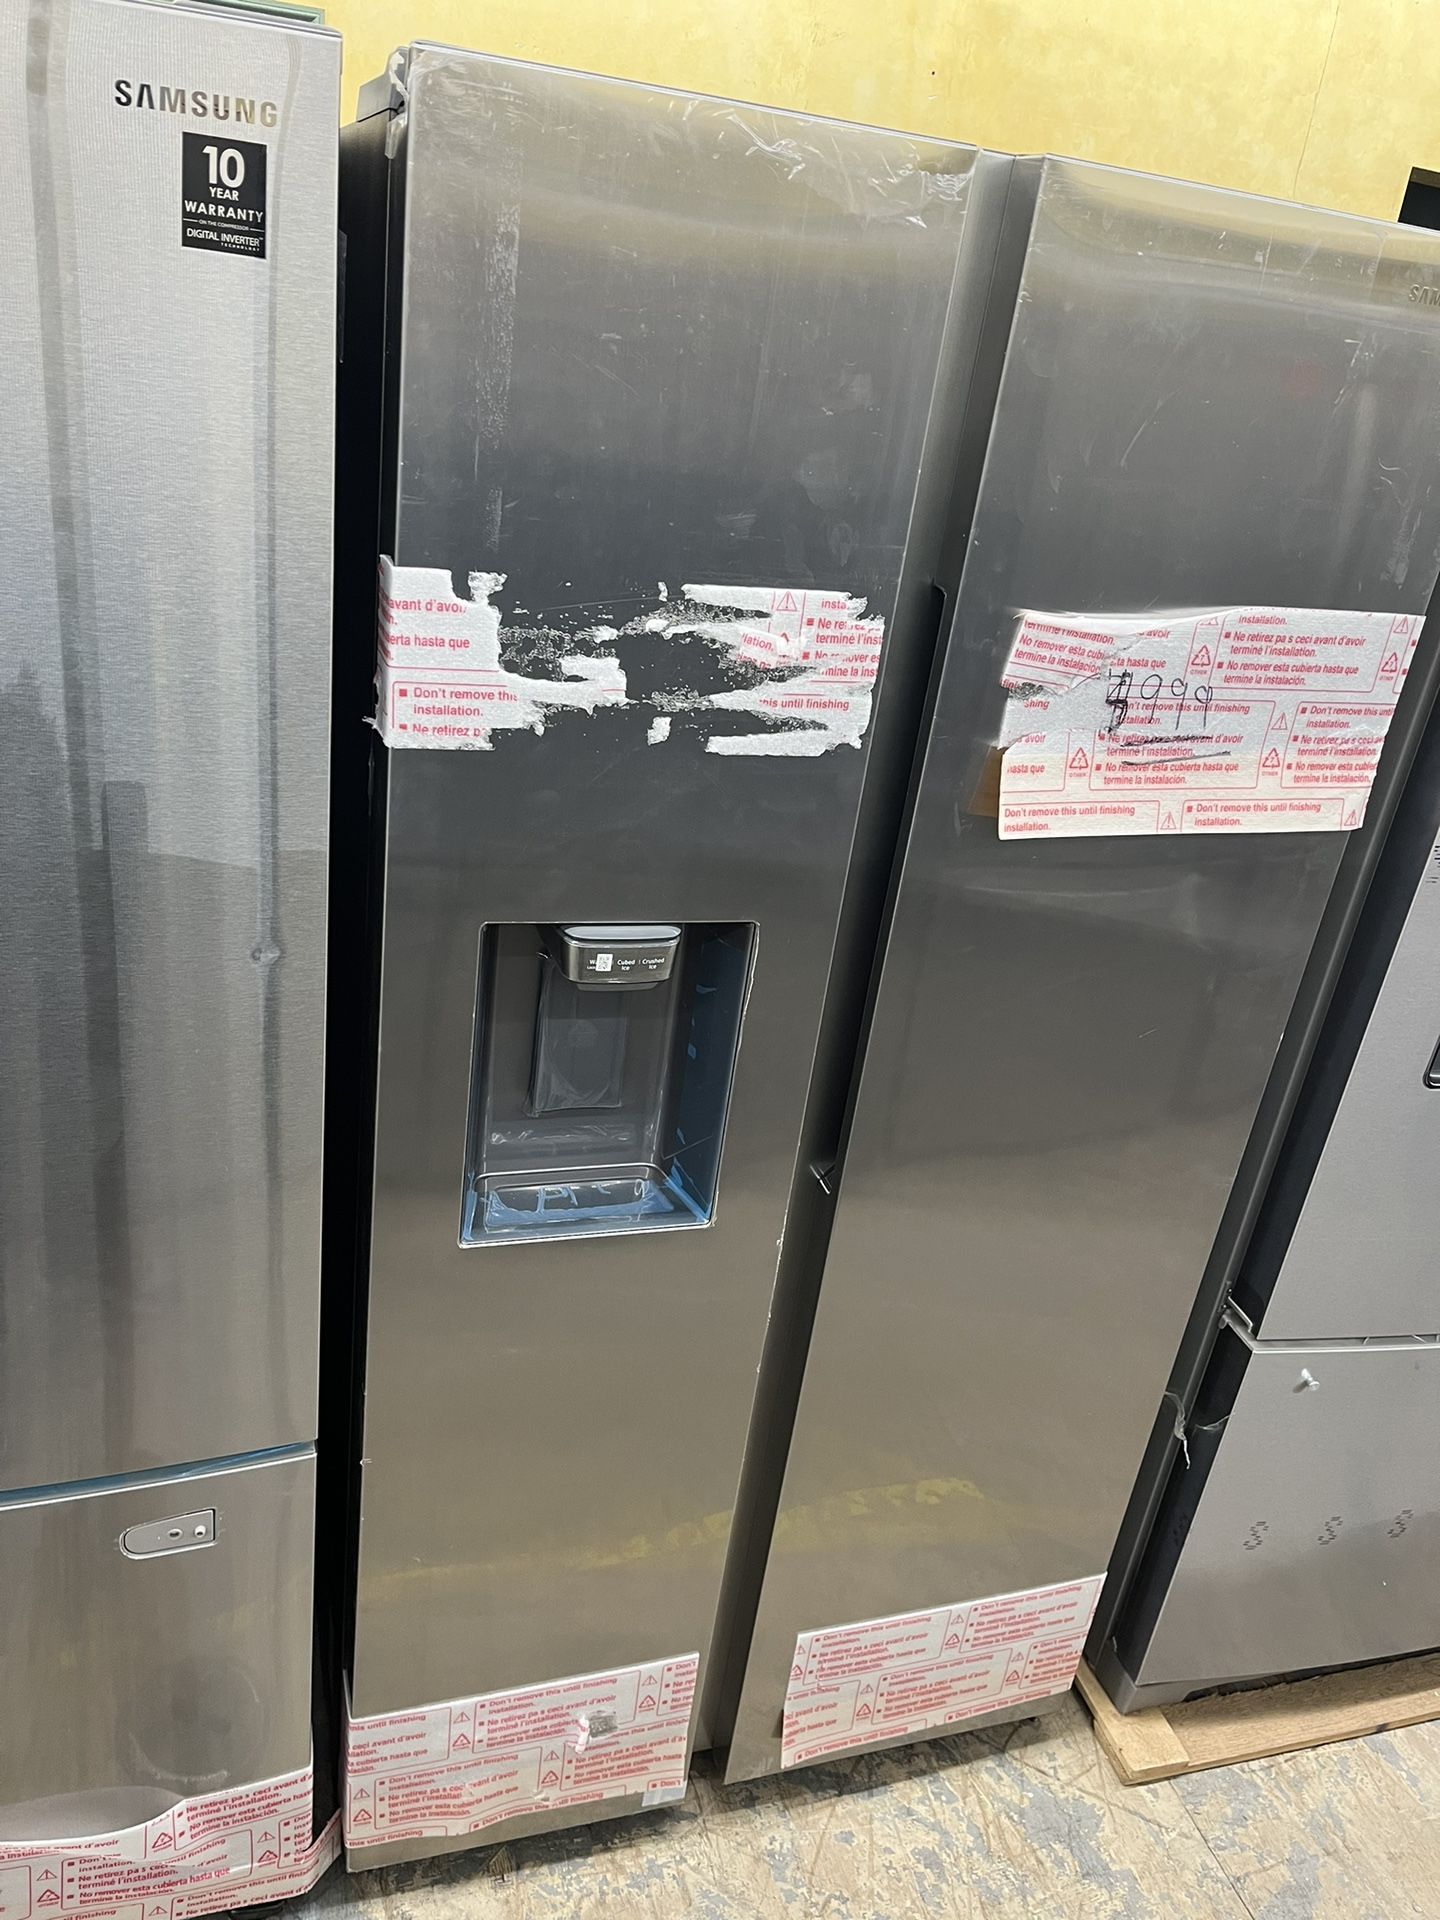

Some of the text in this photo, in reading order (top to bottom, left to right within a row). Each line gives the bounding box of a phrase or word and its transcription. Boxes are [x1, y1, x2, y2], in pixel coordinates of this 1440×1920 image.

[115, 79, 277, 127] SAMSUNG
[202, 145, 245, 188] 10
[209, 187, 239, 201] YEAR
[185, 200, 263, 222] WARRANTY
[187, 228, 220, 240] DIGITAL
[818, 618, 831, 629] Ne
[1239, 616, 1287, 625] installation.
[415, 634, 445, 647] hasta
[449, 638, 470, 650] que
[1233, 631, 1245, 641] Ne
[1247, 632, 1273, 642] retirez
[1275, 635, 1286, 644] pa
[1295, 634, 1312, 644] ceci
[1314, 636, 1338, 646] avant
[1340, 636, 1365, 646] d'avoir
[1019, 634, 1031, 645] No
[1033, 639, 1067, 653] remover
[1069, 646, 1085, 657] esta
[1015, 649, 1047, 662] termine
[1049, 654, 1055, 665] la
[1126, 657, 1149, 668] hasta
[1151, 660, 1166, 671] que
[1227, 661, 1359, 677] No remover esta cubierta hasta que
[1224, 674, 1306, 685] termine la instalación.
[414, 687, 446, 698] Don't
[450, 690, 495, 700] remove
[414, 704, 483, 716] installation.
[781, 699, 803, 708] until
[806, 699, 849, 711] finishing
[1214, 704, 1250, 715] finishing
[1310, 705, 1331, 714] Don't
[1364, 707, 1377, 716] this
[412, 724, 428, 733] Ne
[432, 725, 469, 736] retirez
[1306, 720, 1351, 728] installation.
[1216, 734, 1243, 743] d'avoir
[1300, 735, 1311, 744] Ne
[1030, 764, 1045, 775] que
[1105, 763, 1116, 771] No
[1170, 763, 1200, 772] cubierta
[1202, 763, 1223, 771] hasta
[1225, 764, 1239, 773] que
[1296, 762, 1305, 770] No
[1104, 775, 1133, 784] termine
[1135, 775, 1142, 784] la
[1294, 775, 1320, 783] termine
[1004, 805, 1135, 817] Don't remove this until finishing
[1197, 802, 1321, 813] Don't remove this until finishing
[1004, 822, 1051, 832] installation.
[1195, 817, 1242, 826] installation.
[489, 1698, 511, 1707] Don't
[513, 1692, 544, 1703] remove
[583, 1679, 617, 1689] finishing
[565, 1695, 616, 1710] avant d'avoir
[79, 1861, 135, 1873] installation.
[79, 1869, 178, 1889] terminé l'installation.
[95, 1871, 124, 1879] retirez
[127, 1868, 141, 1877] pa
[94, 1888, 130, 1896] remover
[152, 1876, 187, 1889] cubierta
[190, 1874, 212, 1884] hasta
[214, 1868, 230, 1880] que
